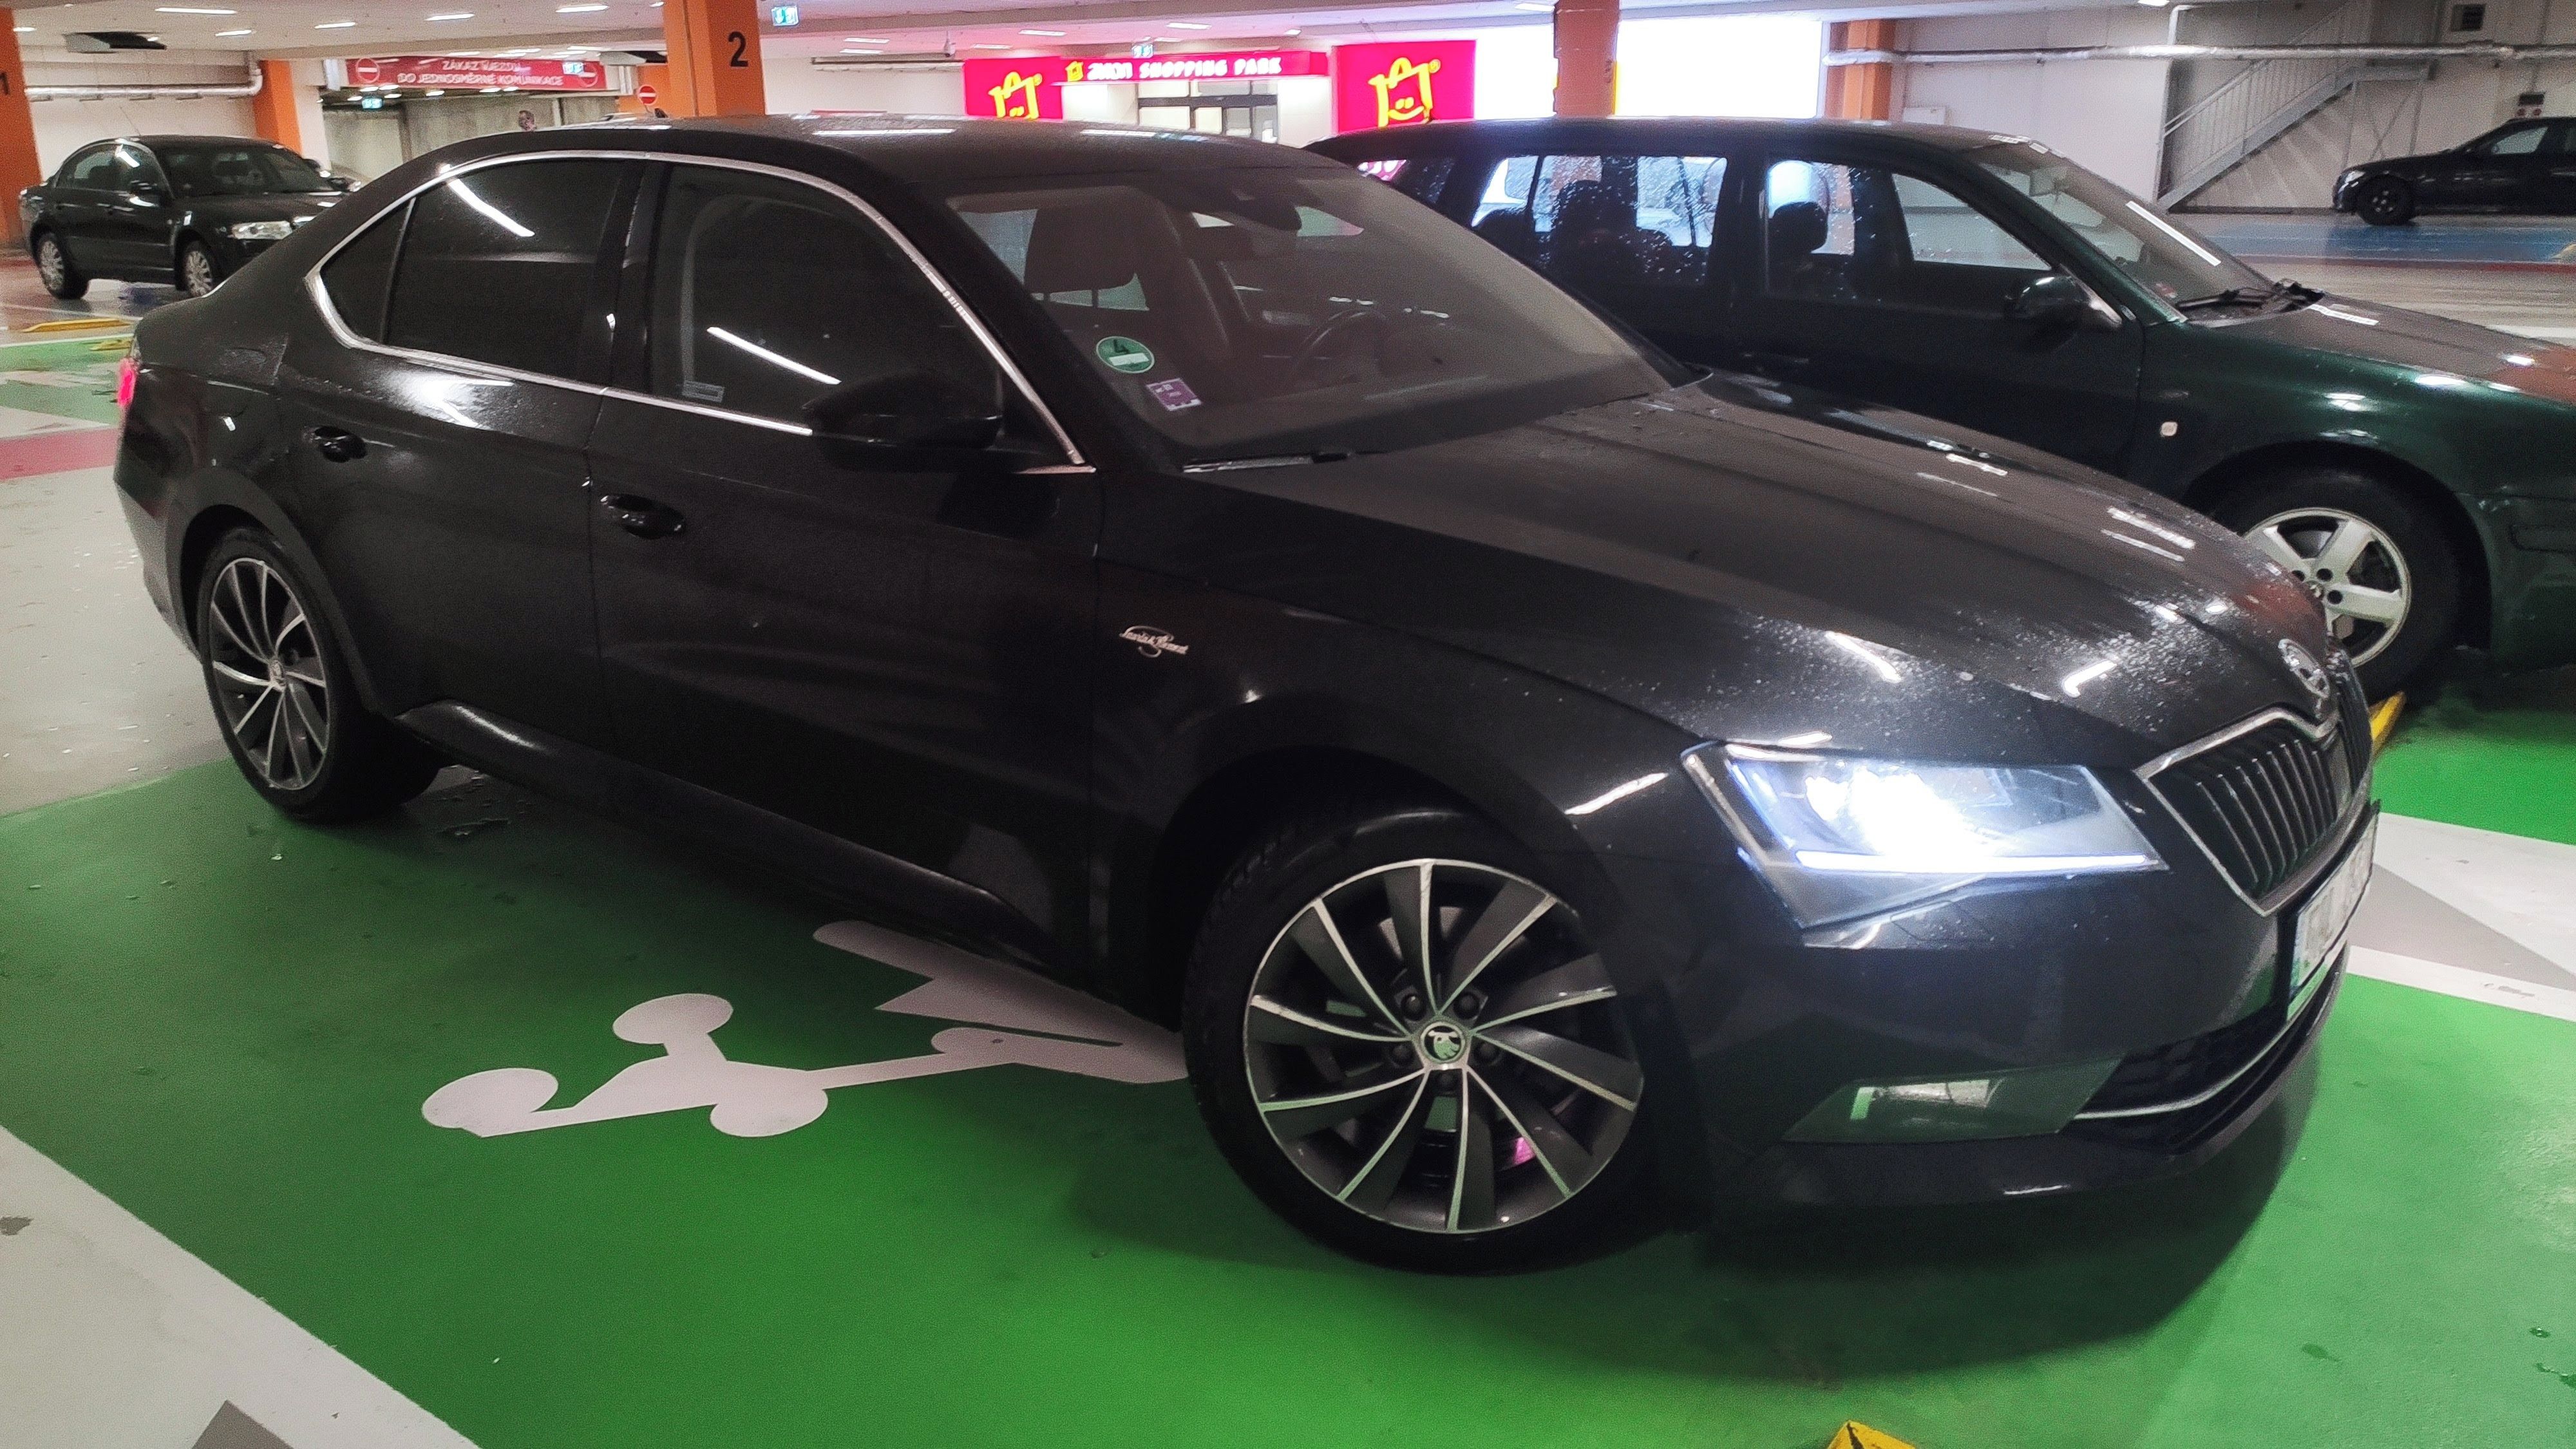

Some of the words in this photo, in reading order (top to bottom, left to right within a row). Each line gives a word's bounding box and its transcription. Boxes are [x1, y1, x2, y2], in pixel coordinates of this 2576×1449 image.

[728, 31, 749, 67] 2
[397, 72, 417, 83] DO
[1139, 59, 1227, 78] SHOPPING
[1234, 57, 1282, 75] PARK
